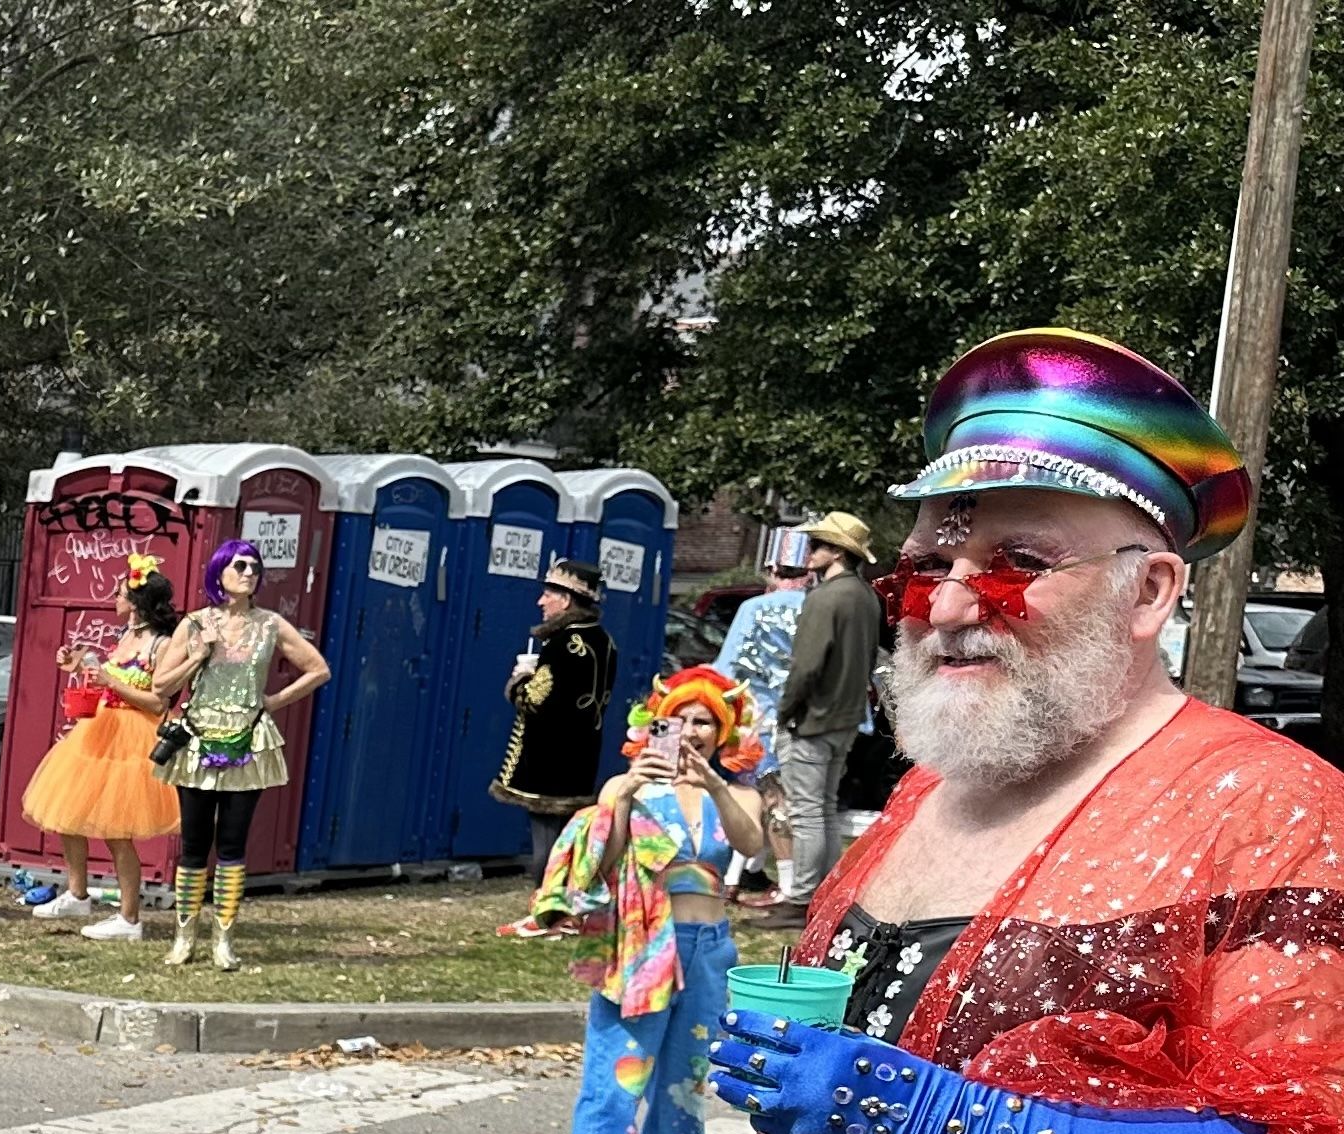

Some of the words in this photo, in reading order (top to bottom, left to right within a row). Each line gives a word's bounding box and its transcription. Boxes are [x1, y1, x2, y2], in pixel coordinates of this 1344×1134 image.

[258, 520, 276, 537] CITY
[277, 518, 287, 537] OF
[262, 538, 296, 560] ORLEANS
[385, 535, 403, 553] CITY
[404, 540, 414, 555] OF
[505, 531, 521, 547] CITY
[521, 533, 531, 548] OF
[372, 551, 388, 573] NEW
[388, 554, 422, 581] ORLEANS
[492, 547, 508, 567] NEW
[508, 549, 540, 571] ORLEANS
